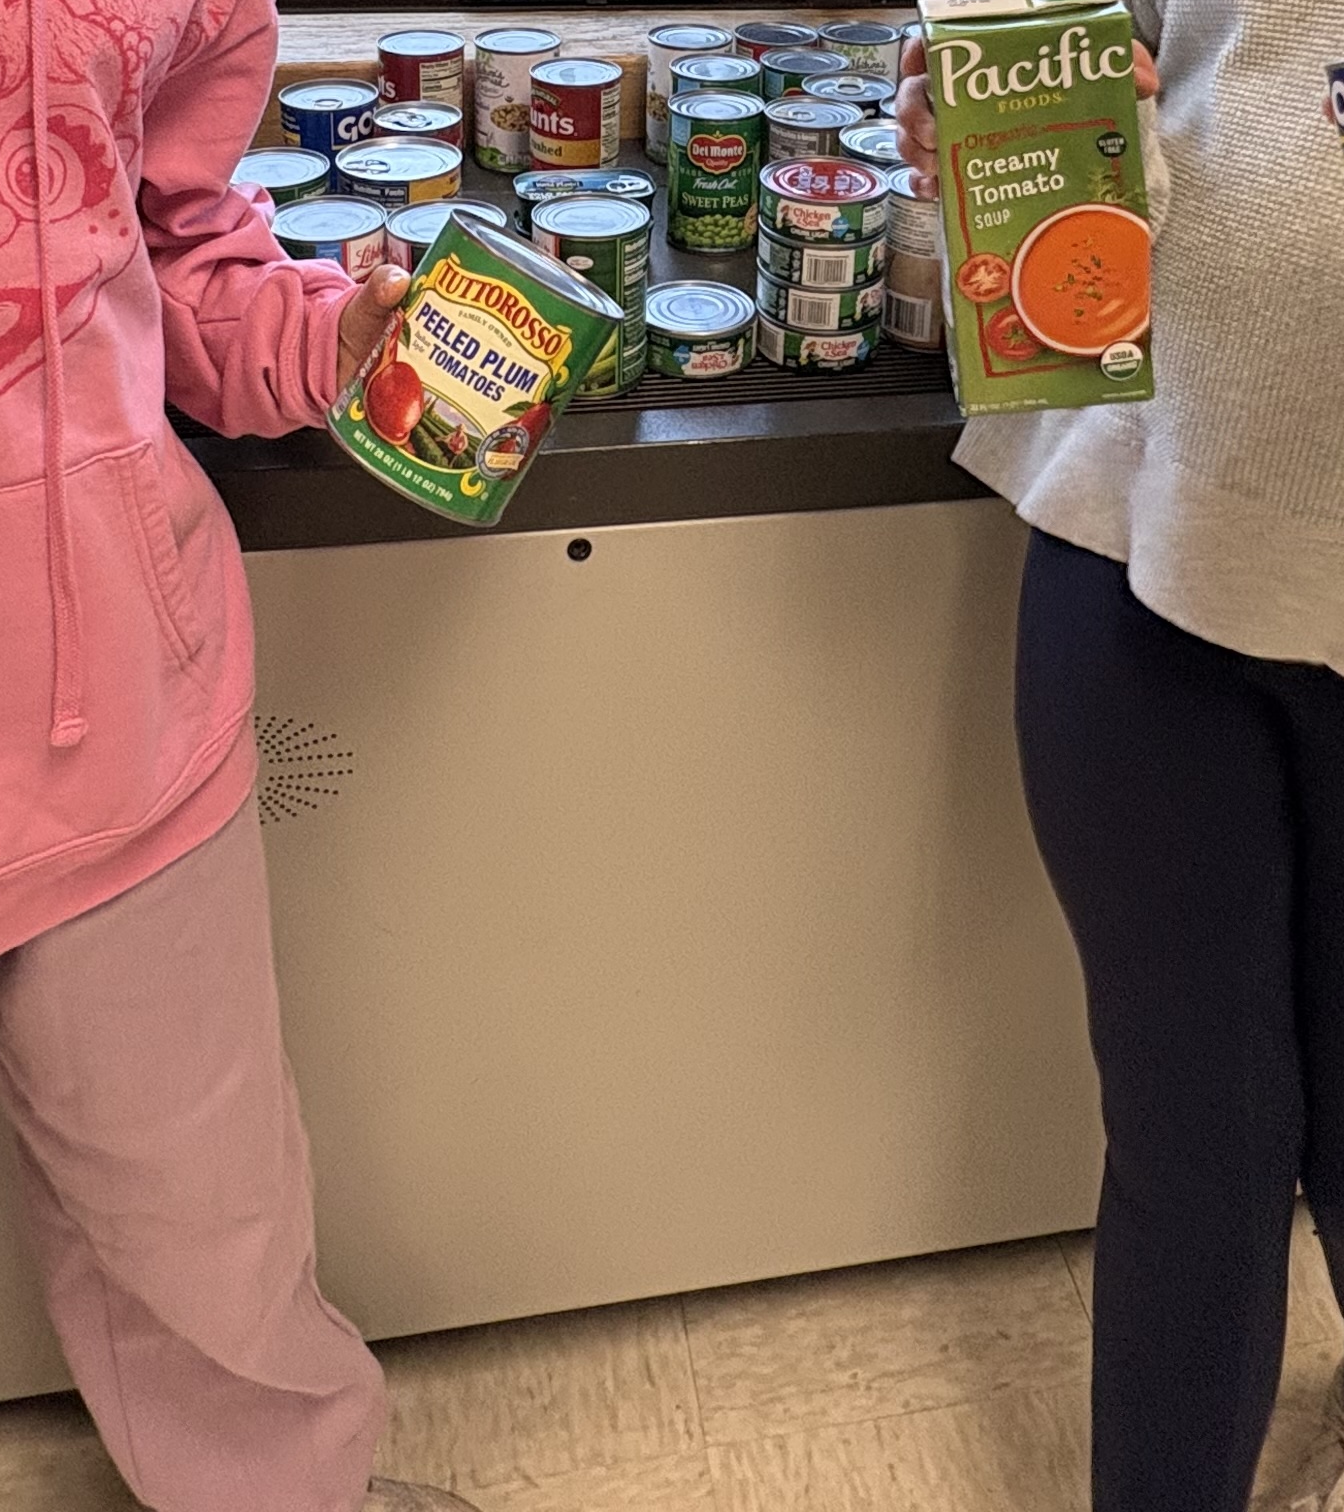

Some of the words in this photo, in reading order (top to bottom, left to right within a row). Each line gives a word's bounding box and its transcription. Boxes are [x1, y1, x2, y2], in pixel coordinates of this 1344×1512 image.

[928, 26, 1135, 107] Pacific
[998, 92, 1063, 113] FOODS
[692, 144, 708, 156] Del
[710, 145, 743, 157] Monte
[966, 147, 1061, 180] Creamy
[682, 192, 720, 208] SWEET
[722, 194, 749, 208] PEAS
[968, 173, 1065, 206] Tomato
[793, 207, 831, 220] Chicken
[974, 208, 1011, 230] SOUP
[438, 262, 563, 356] TUTTOROSSO
[457, 310, 488, 327] FAMILY
[415, 301, 481, 361] PEELED
[479, 349, 540, 394] PLUM
[428, 343, 506, 402] TOMATOES
